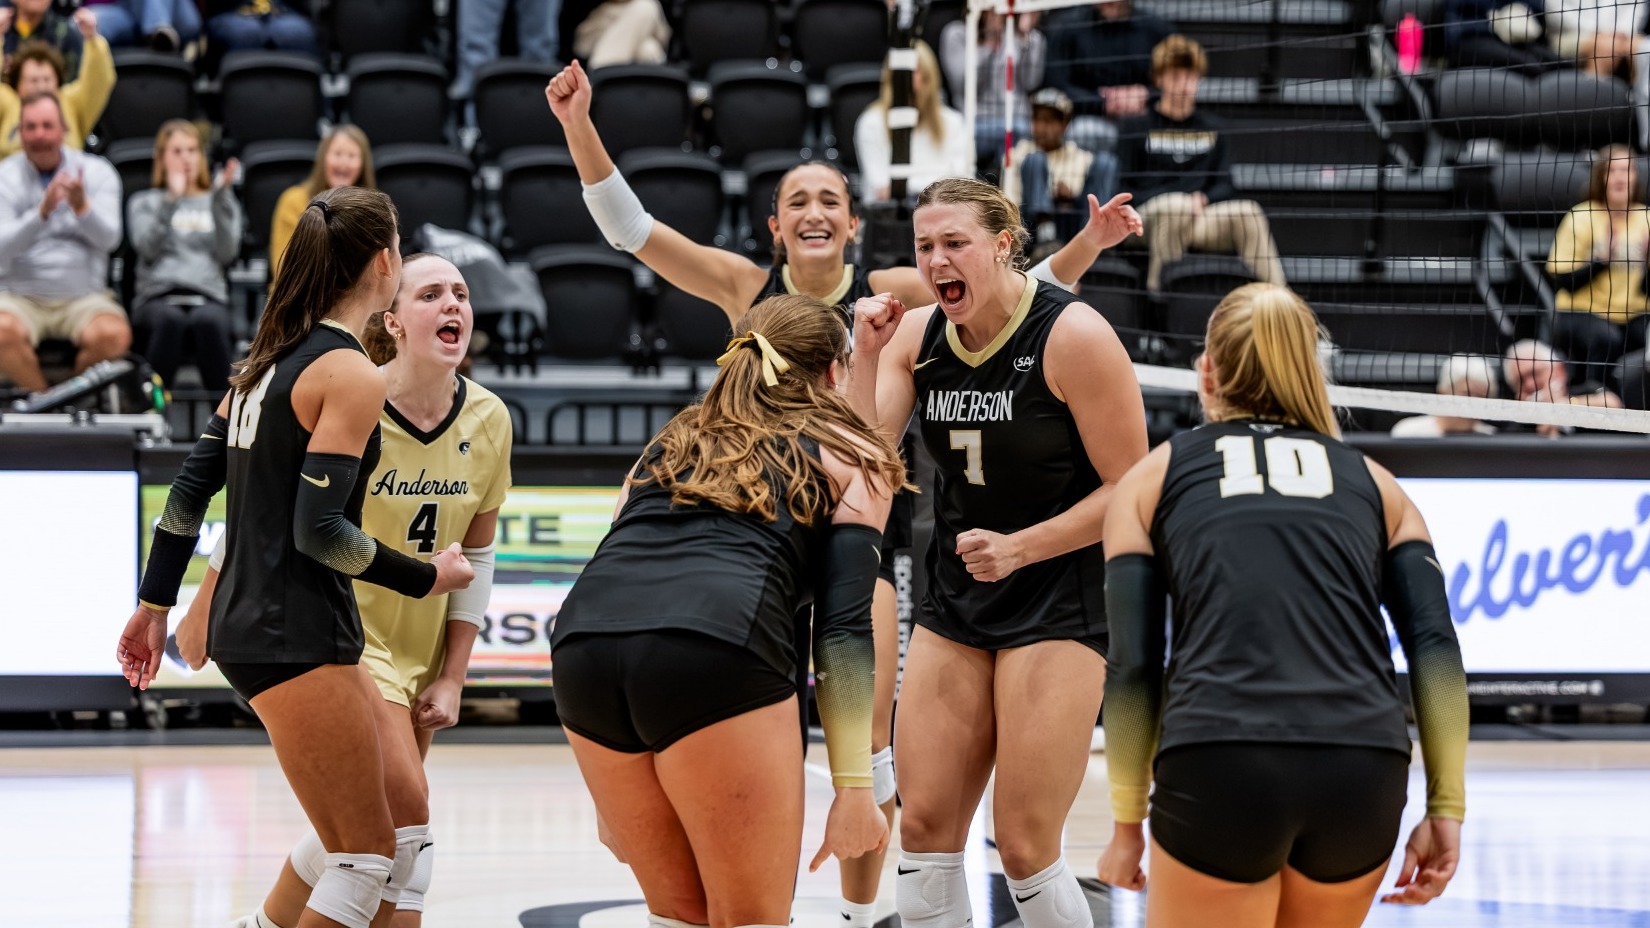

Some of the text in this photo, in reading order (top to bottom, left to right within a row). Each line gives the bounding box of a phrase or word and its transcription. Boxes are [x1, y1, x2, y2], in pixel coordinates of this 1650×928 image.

[926, 390, 1014, 422] ANDERSON
[949, 430, 985, 486] 7
[1215, 435, 1334, 499] 10
[371, 469, 469, 495] Anderson
[406, 502, 439, 554] 4
[498, 515, 561, 544] TE
